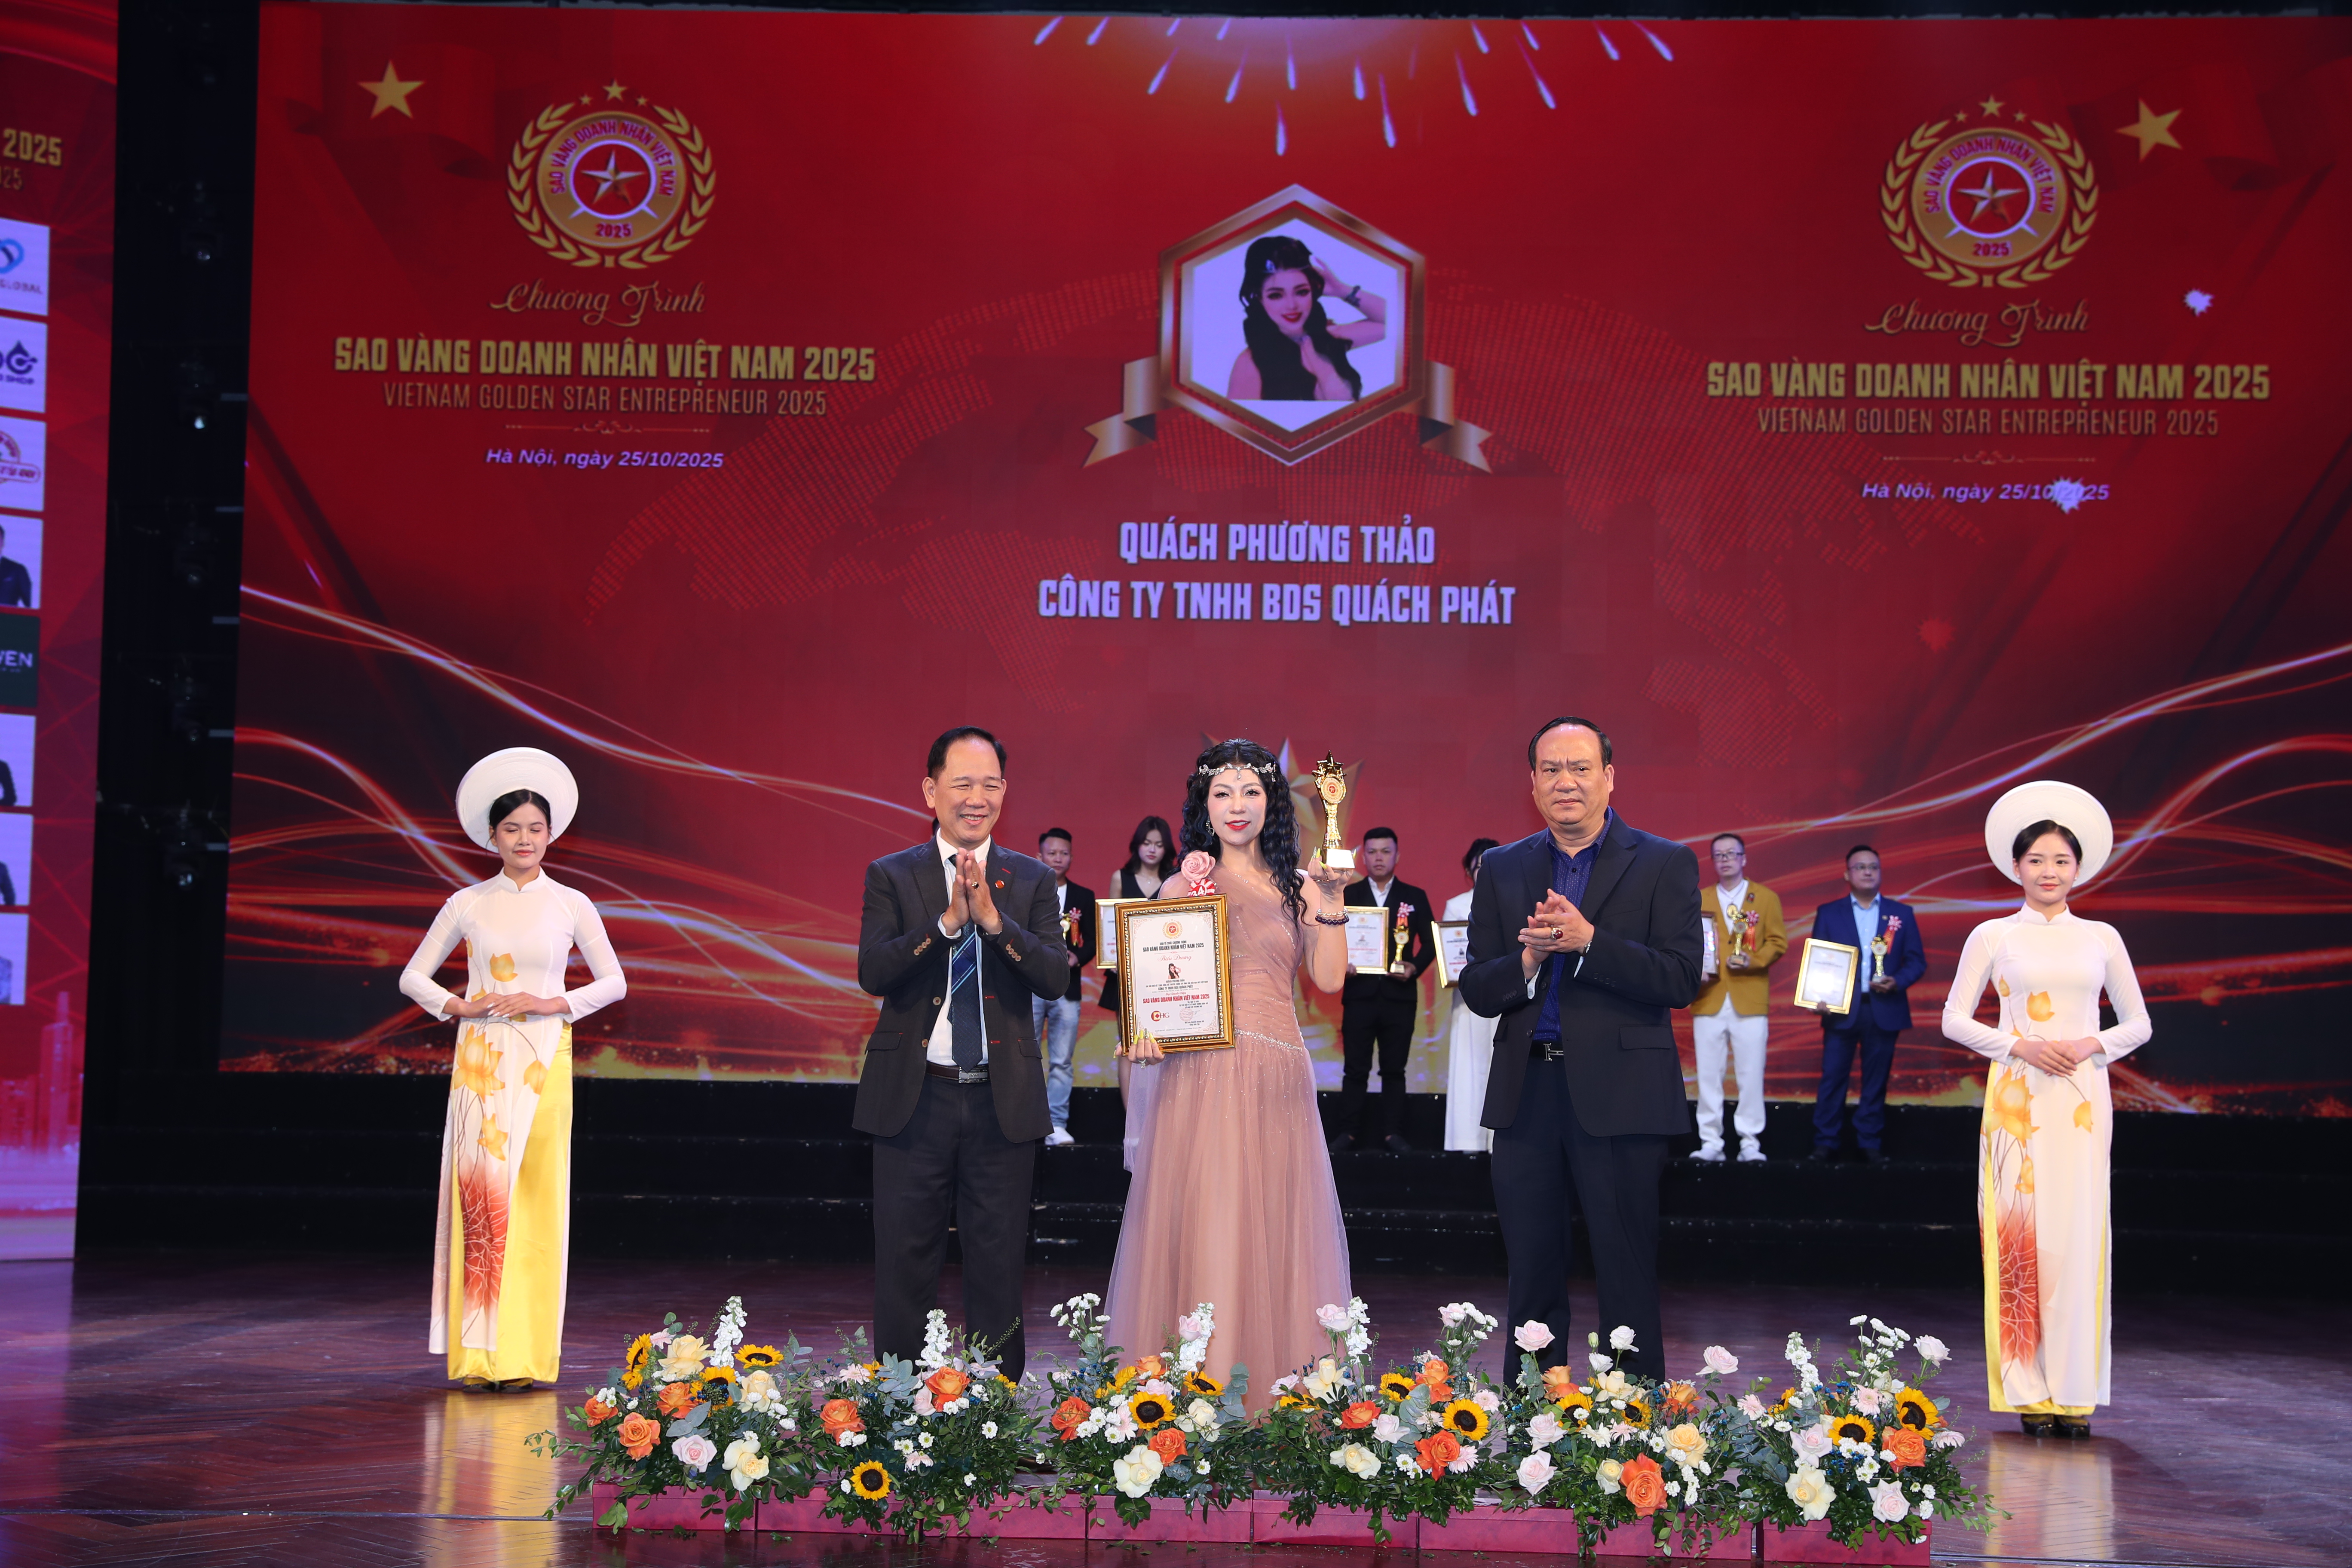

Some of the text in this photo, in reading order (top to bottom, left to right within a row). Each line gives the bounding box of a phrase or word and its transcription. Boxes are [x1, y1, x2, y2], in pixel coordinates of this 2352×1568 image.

[3, 128, 62, 167] 2025
[550, 171, 566, 194] SAO
[575, 119, 618, 144] DOANH
[659, 169, 677, 197] NAM
[0, 165, 23, 190] 25
[1923, 190, 1941, 213] SAO
[1950, 135, 1994, 161] DOANH
[2038, 186, 2057, 214] NAM
[595, 222, 633, 238] 2025
[1972, 241, 2012, 257] 2025
[490, 278, 706, 327] Chương Trình
[1865, 298, 2088, 347] Chương Trình
[334, 333, 876, 386] SAO VÀNG DOANH NHÂN VIỆT NAM 2025
[383, 382, 827, 415] VIETNAM GOLDEN STAR ENTREPRENEUR 2025
[1707, 357, 2270, 407] SAO VÀNG DOANH NHÂN VIỆT NAM 2025
[1758, 407, 2218, 436] VIETNAM GOLDEN STAR ENTREPRENEUR 2025
[486, 448, 724, 469] Hà Nội, ngày 25/10/2025
[1862, 483, 1890, 498] Hà
[1895, 483, 1935, 501] Nội,
[1943, 484, 1994, 503] ngày
[1120, 514, 1435, 564] QUÁCH PHƯƠNG THẢO
[1038, 573, 1516, 626] CÔNG TY TNHH BDS QUÁCH PHÁT
